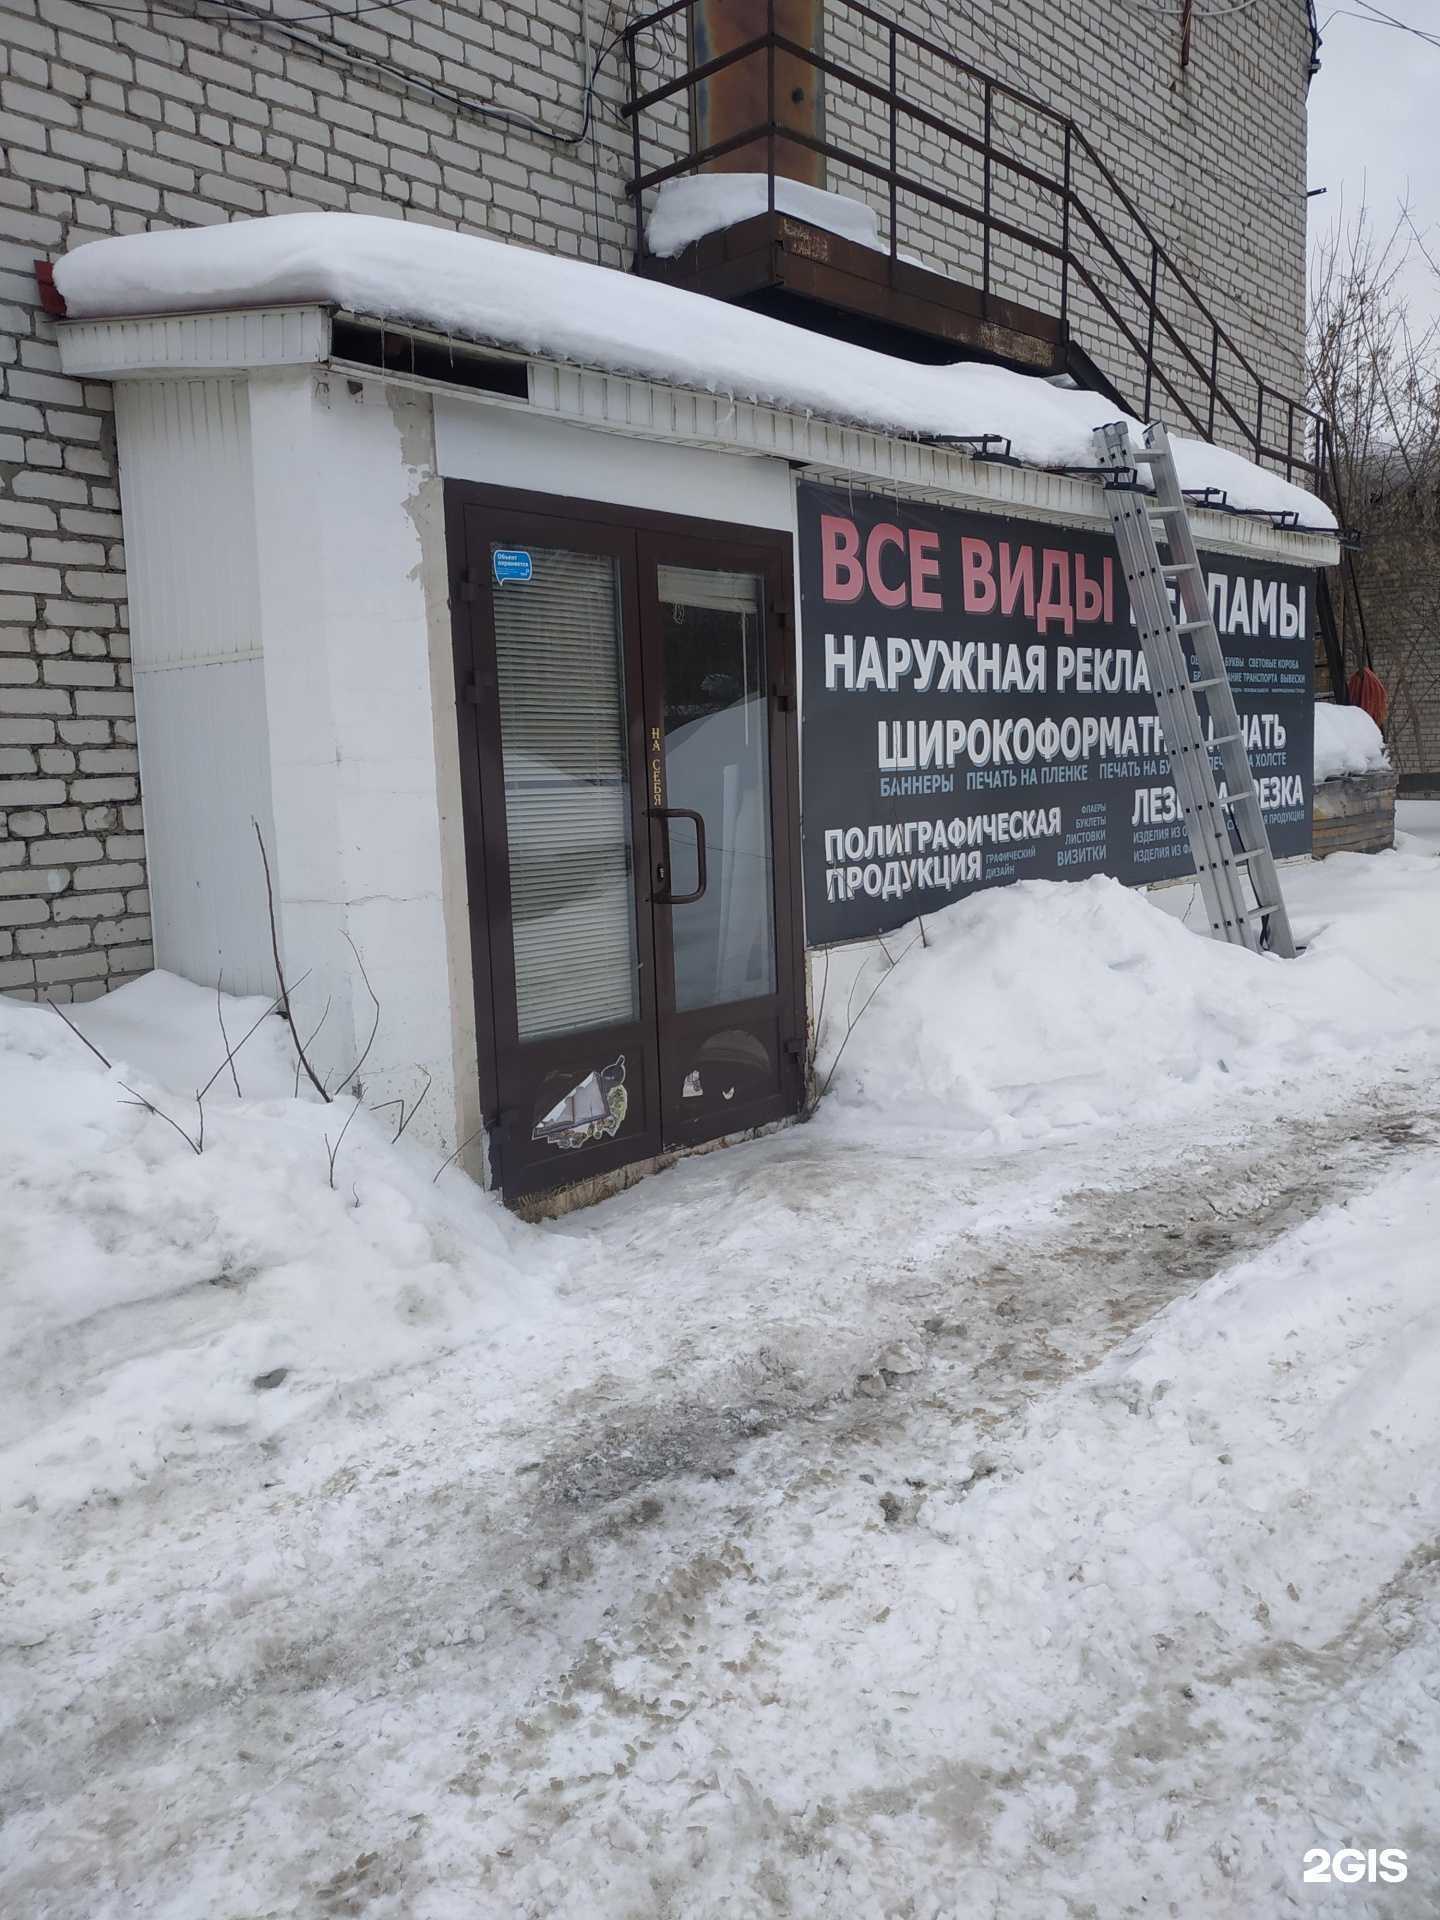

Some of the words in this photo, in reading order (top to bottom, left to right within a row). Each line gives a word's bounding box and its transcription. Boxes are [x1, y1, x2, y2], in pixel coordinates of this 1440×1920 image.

[820, 514, 943, 610] ВСЕ
[960, 536, 1114, 636] ВИДЫ
[824, 634, 1047, 692] НАРУЖНАЯ
[1056, 645, 1186, 694] РЕКЛА
[651, 728, 661, 751] НА
[877, 716, 1200, 771] ШИРОКОФОРМАТН
[1100, 761, 1141, 779] ПЕЧАТЬ
[1143, 760, 1157, 776] НА
[1256, 752, 1287, 768] ХОЛСТЕ
[652, 759, 662, 806] СЕБЯ
[880, 774, 954, 797] БАННЕРЫ
[966, 768, 1017, 791] ПЕЧАТЬ
[1020, 767, 1038, 785] НА
[1040, 765, 1088, 784] ПЛЕНКЕ
[1075, 816, 1107, 829] БУКЛЕТЫ
[825, 807, 1062, 865] ПОЛИГРАФИЧЕСКАЯ
[1064, 830, 1107, 846] ЛИСТОВКИ
[1133, 828, 1170, 845] ИЗДЕЛИЯ
[1170, 825, 1181, 839] ИЗ
[985, 846, 1037, 864] ГРАФИЧЕСКИЙ
[1056, 845, 1107, 867] ВИЗИТКИ
[1133, 846, 1170, 865] ИЗДЕЛИЯ
[1171, 844, 1181, 857] ИЗ
[826, 850, 983, 903] ПРОДУКЦИЯ
[985, 864, 1015, 880] ДИЗАЙН
